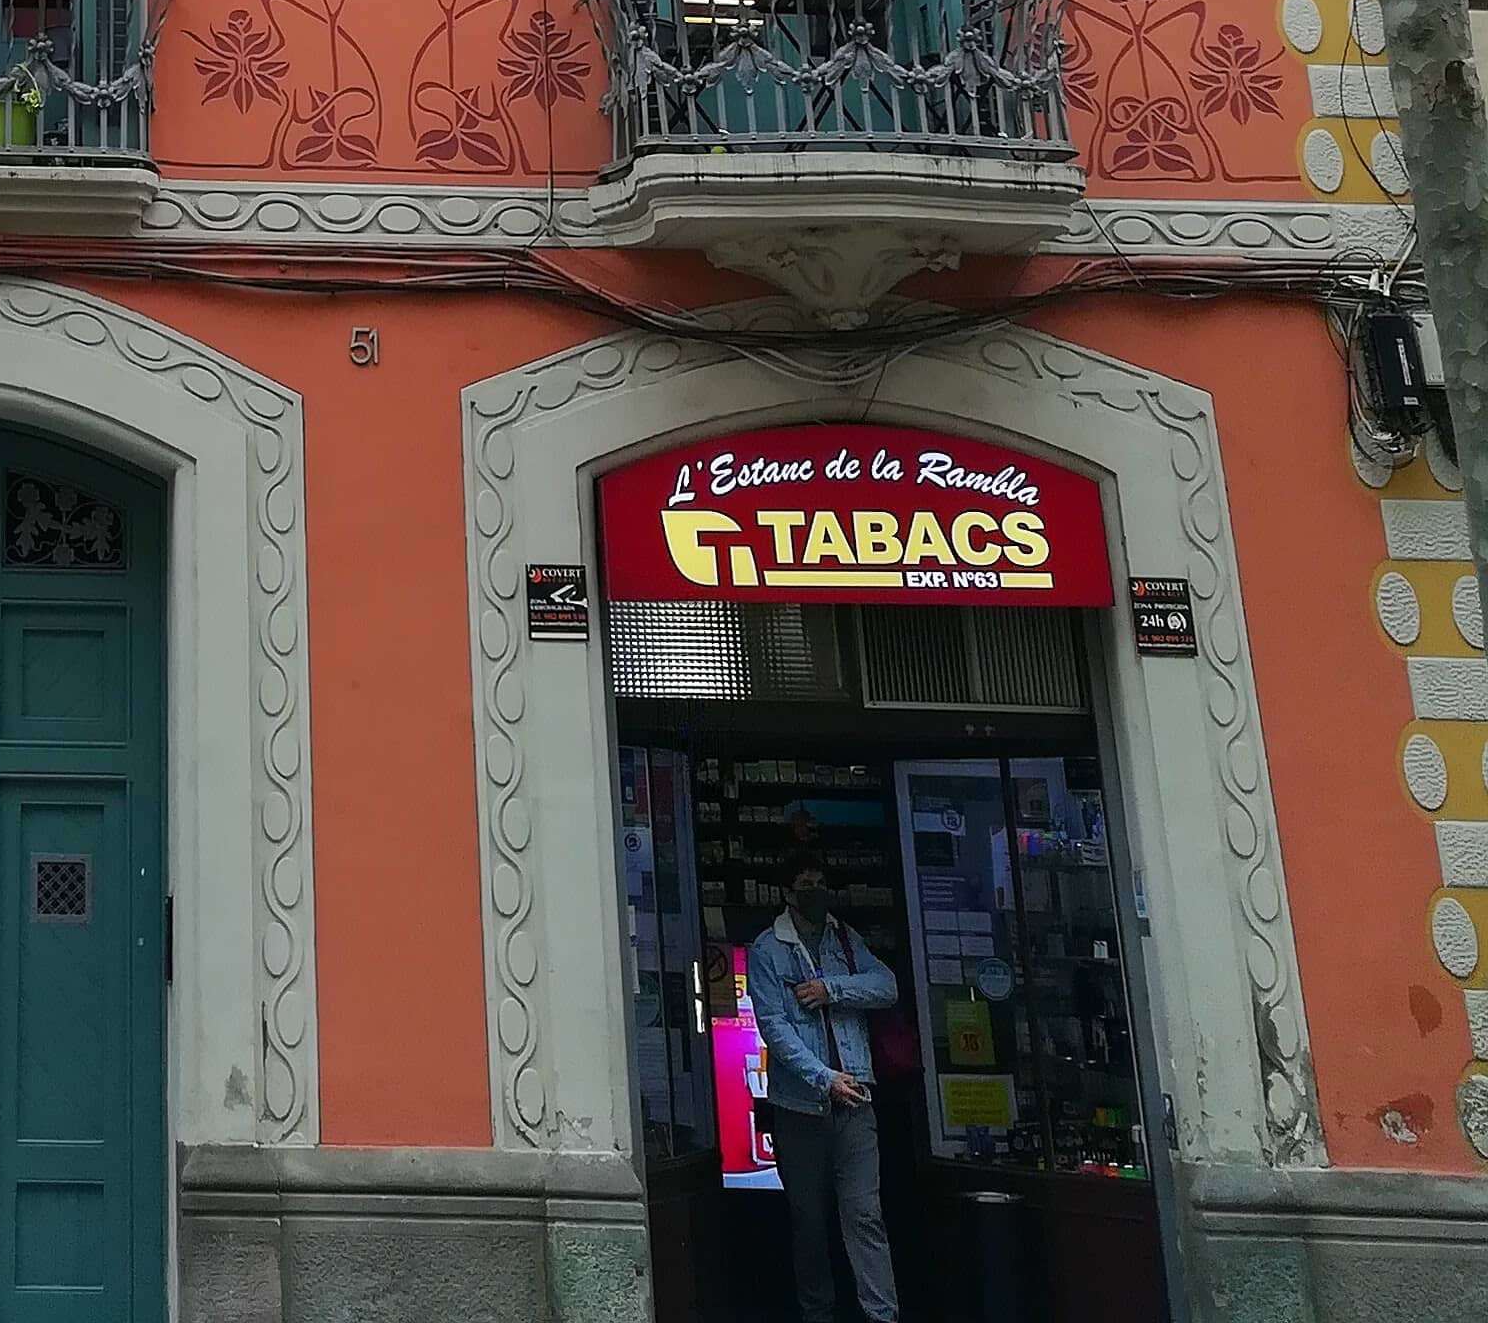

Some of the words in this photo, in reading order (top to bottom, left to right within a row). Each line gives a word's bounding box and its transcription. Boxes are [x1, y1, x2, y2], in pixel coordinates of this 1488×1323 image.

[350, 327, 379, 364] 51
[668, 448, 814, 507] L'Estanc
[824, 449, 861, 481] de
[871, 448, 904, 481] la
[916, 451, 1041, 506] Rambla
[757, 509, 1051, 567] TABACS
[542, 568, 582, 578] COVERT
[906, 571, 949, 589] EXP.
[952, 571, 999, 589] Nº63
[1145, 581, 1185, 591] COVERT
[1139, 613, 1165, 628] 24h
